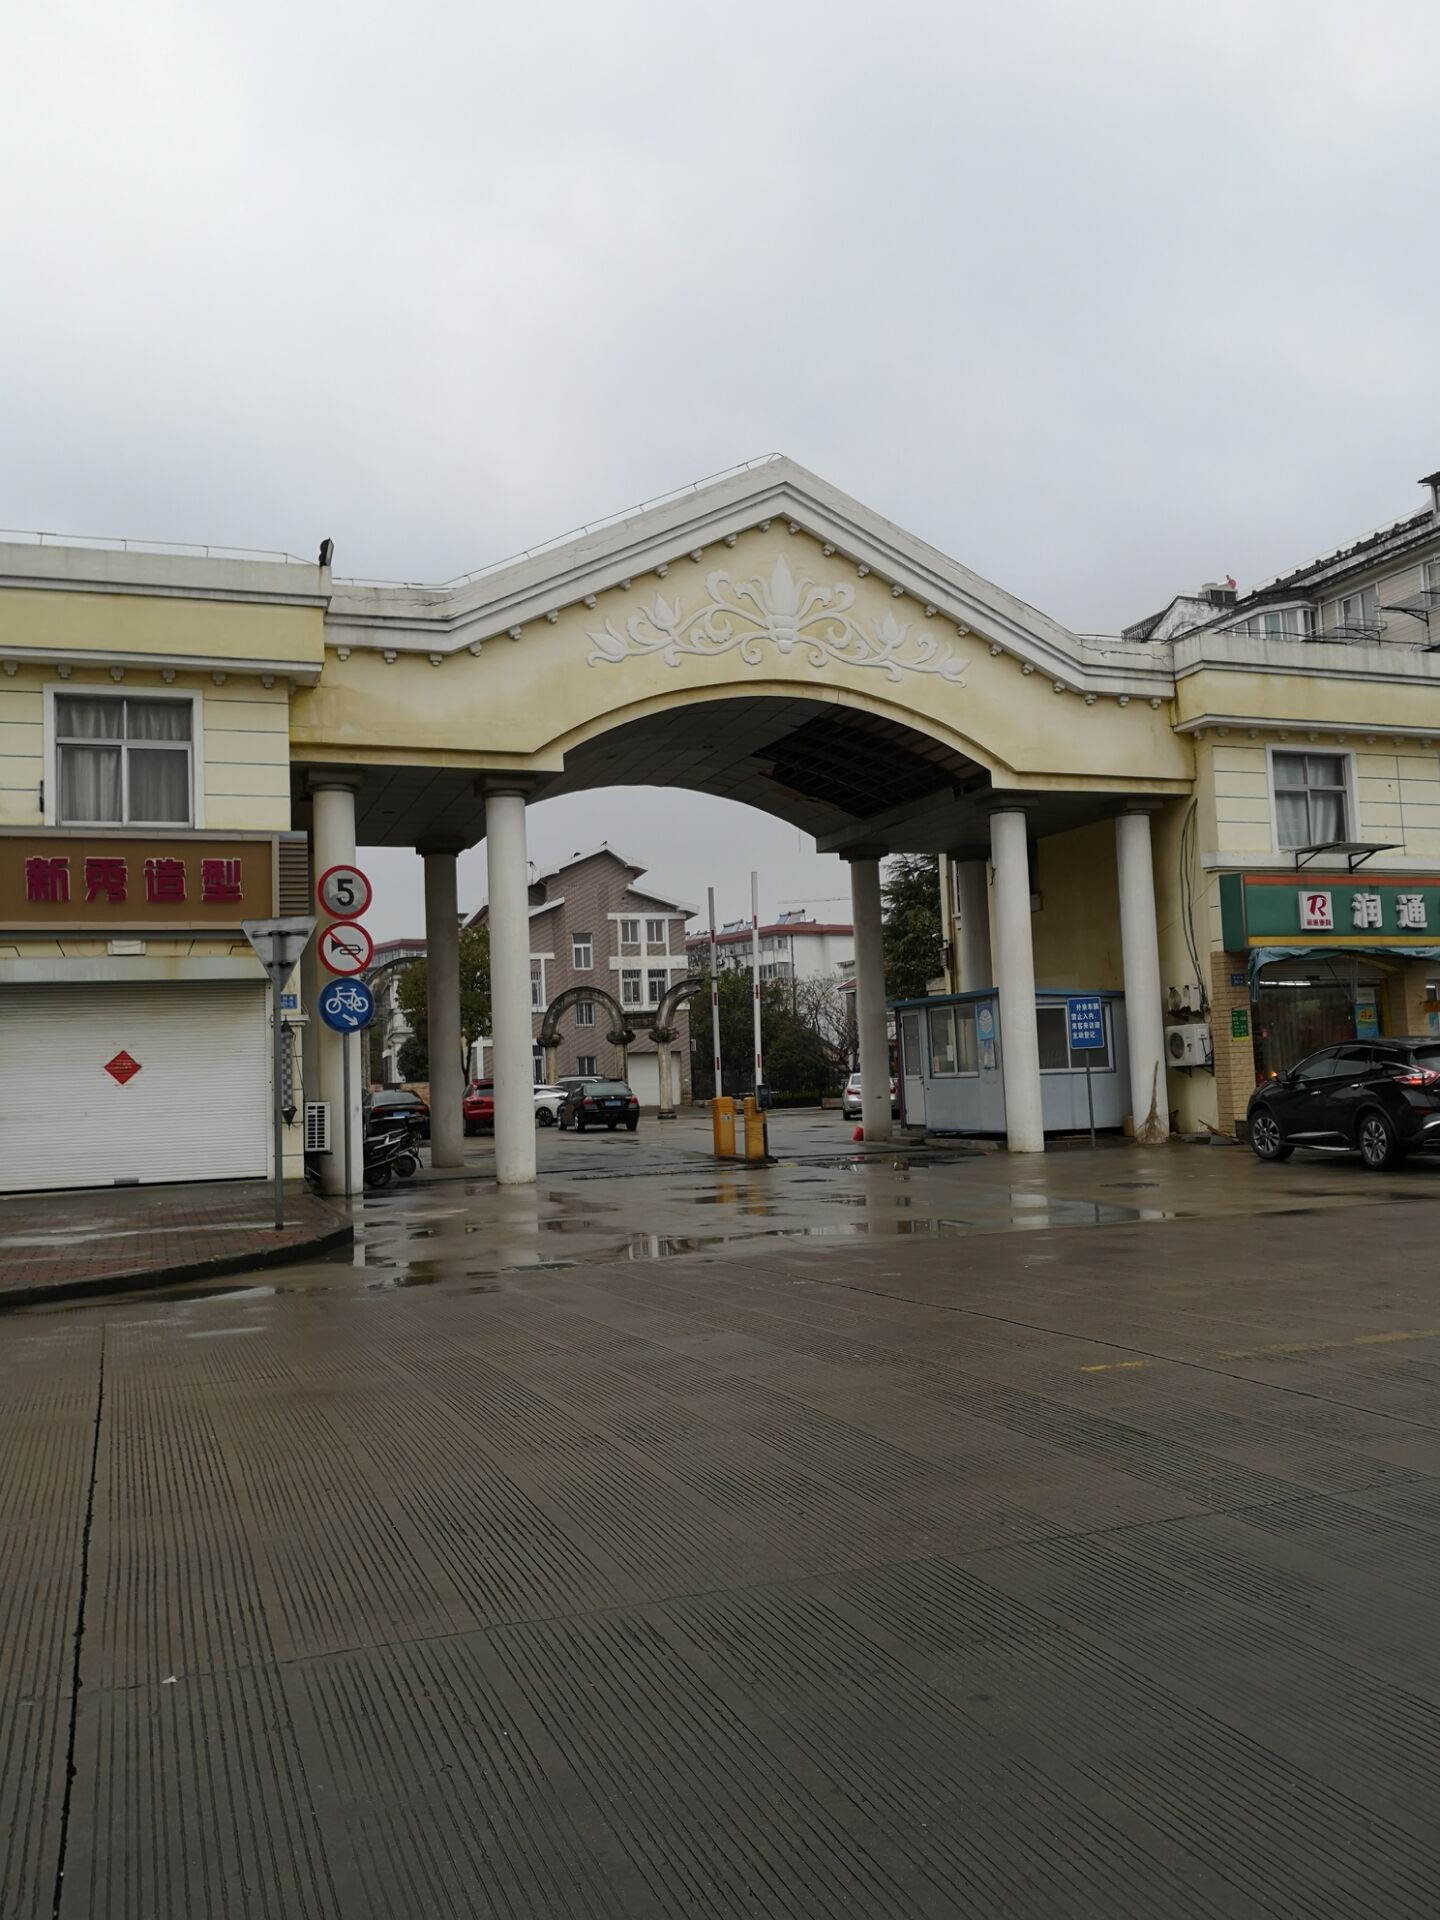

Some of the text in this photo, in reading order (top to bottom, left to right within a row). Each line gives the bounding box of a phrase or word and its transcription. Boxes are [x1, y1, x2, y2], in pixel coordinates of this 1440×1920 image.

[25, 856, 243, 903] 新秀造型
[336, 878, 354, 906] 5
[1352, 893, 1428, 928] 润通
